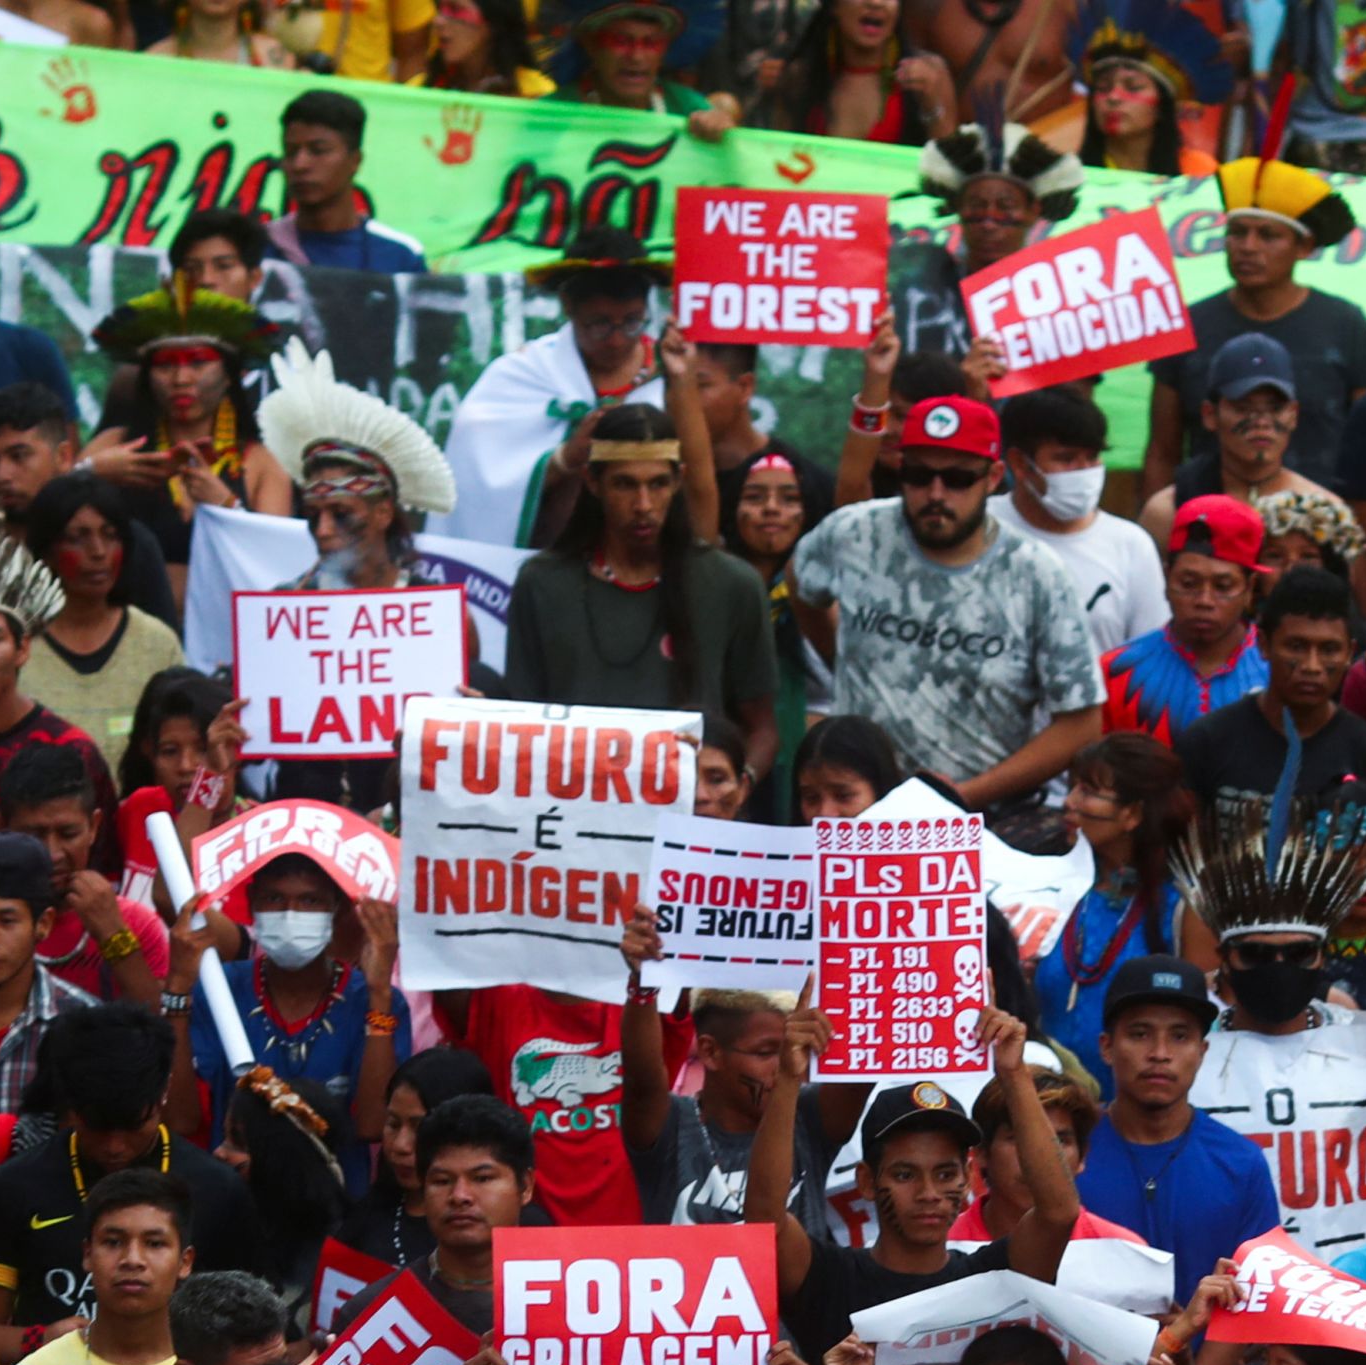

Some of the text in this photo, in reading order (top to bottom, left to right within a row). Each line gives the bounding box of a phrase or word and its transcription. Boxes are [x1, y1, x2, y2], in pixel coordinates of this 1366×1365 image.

[704, 200, 858, 240] WE ARE
[739, 243, 818, 279] THE
[969, 232, 1172, 335] FORA
[678, 282, 880, 335] FOREST
[266, 601, 433, 641] WE ARE
[310, 648, 392, 684] THE
[268, 693, 433, 745] LAN
[417, 716, 682, 807] FUTURO
[199, 805, 392, 872] FORA
[535, 806, 564, 851] É
[197, 825, 398, 903] GRILAGEM!
[917, 856, 980, 892] DA
[413, 852, 641, 926] INDÍGEN
[658, 868, 814, 911] GENOUS
[819, 897, 985, 939] MORTE:
[848, 946, 929, 970] PL 191
[848, 971, 937, 994] PL 490
[848, 996, 953, 1020] PL 2633
[848, 1022, 933, 1045] PL 510
[848, 1047, 949, 1071] PL 2156
[530, 1104, 622, 1133] ACOST
[1265, 1087, 1296, 1127] O
[501, 1256, 768, 1337] FORA
